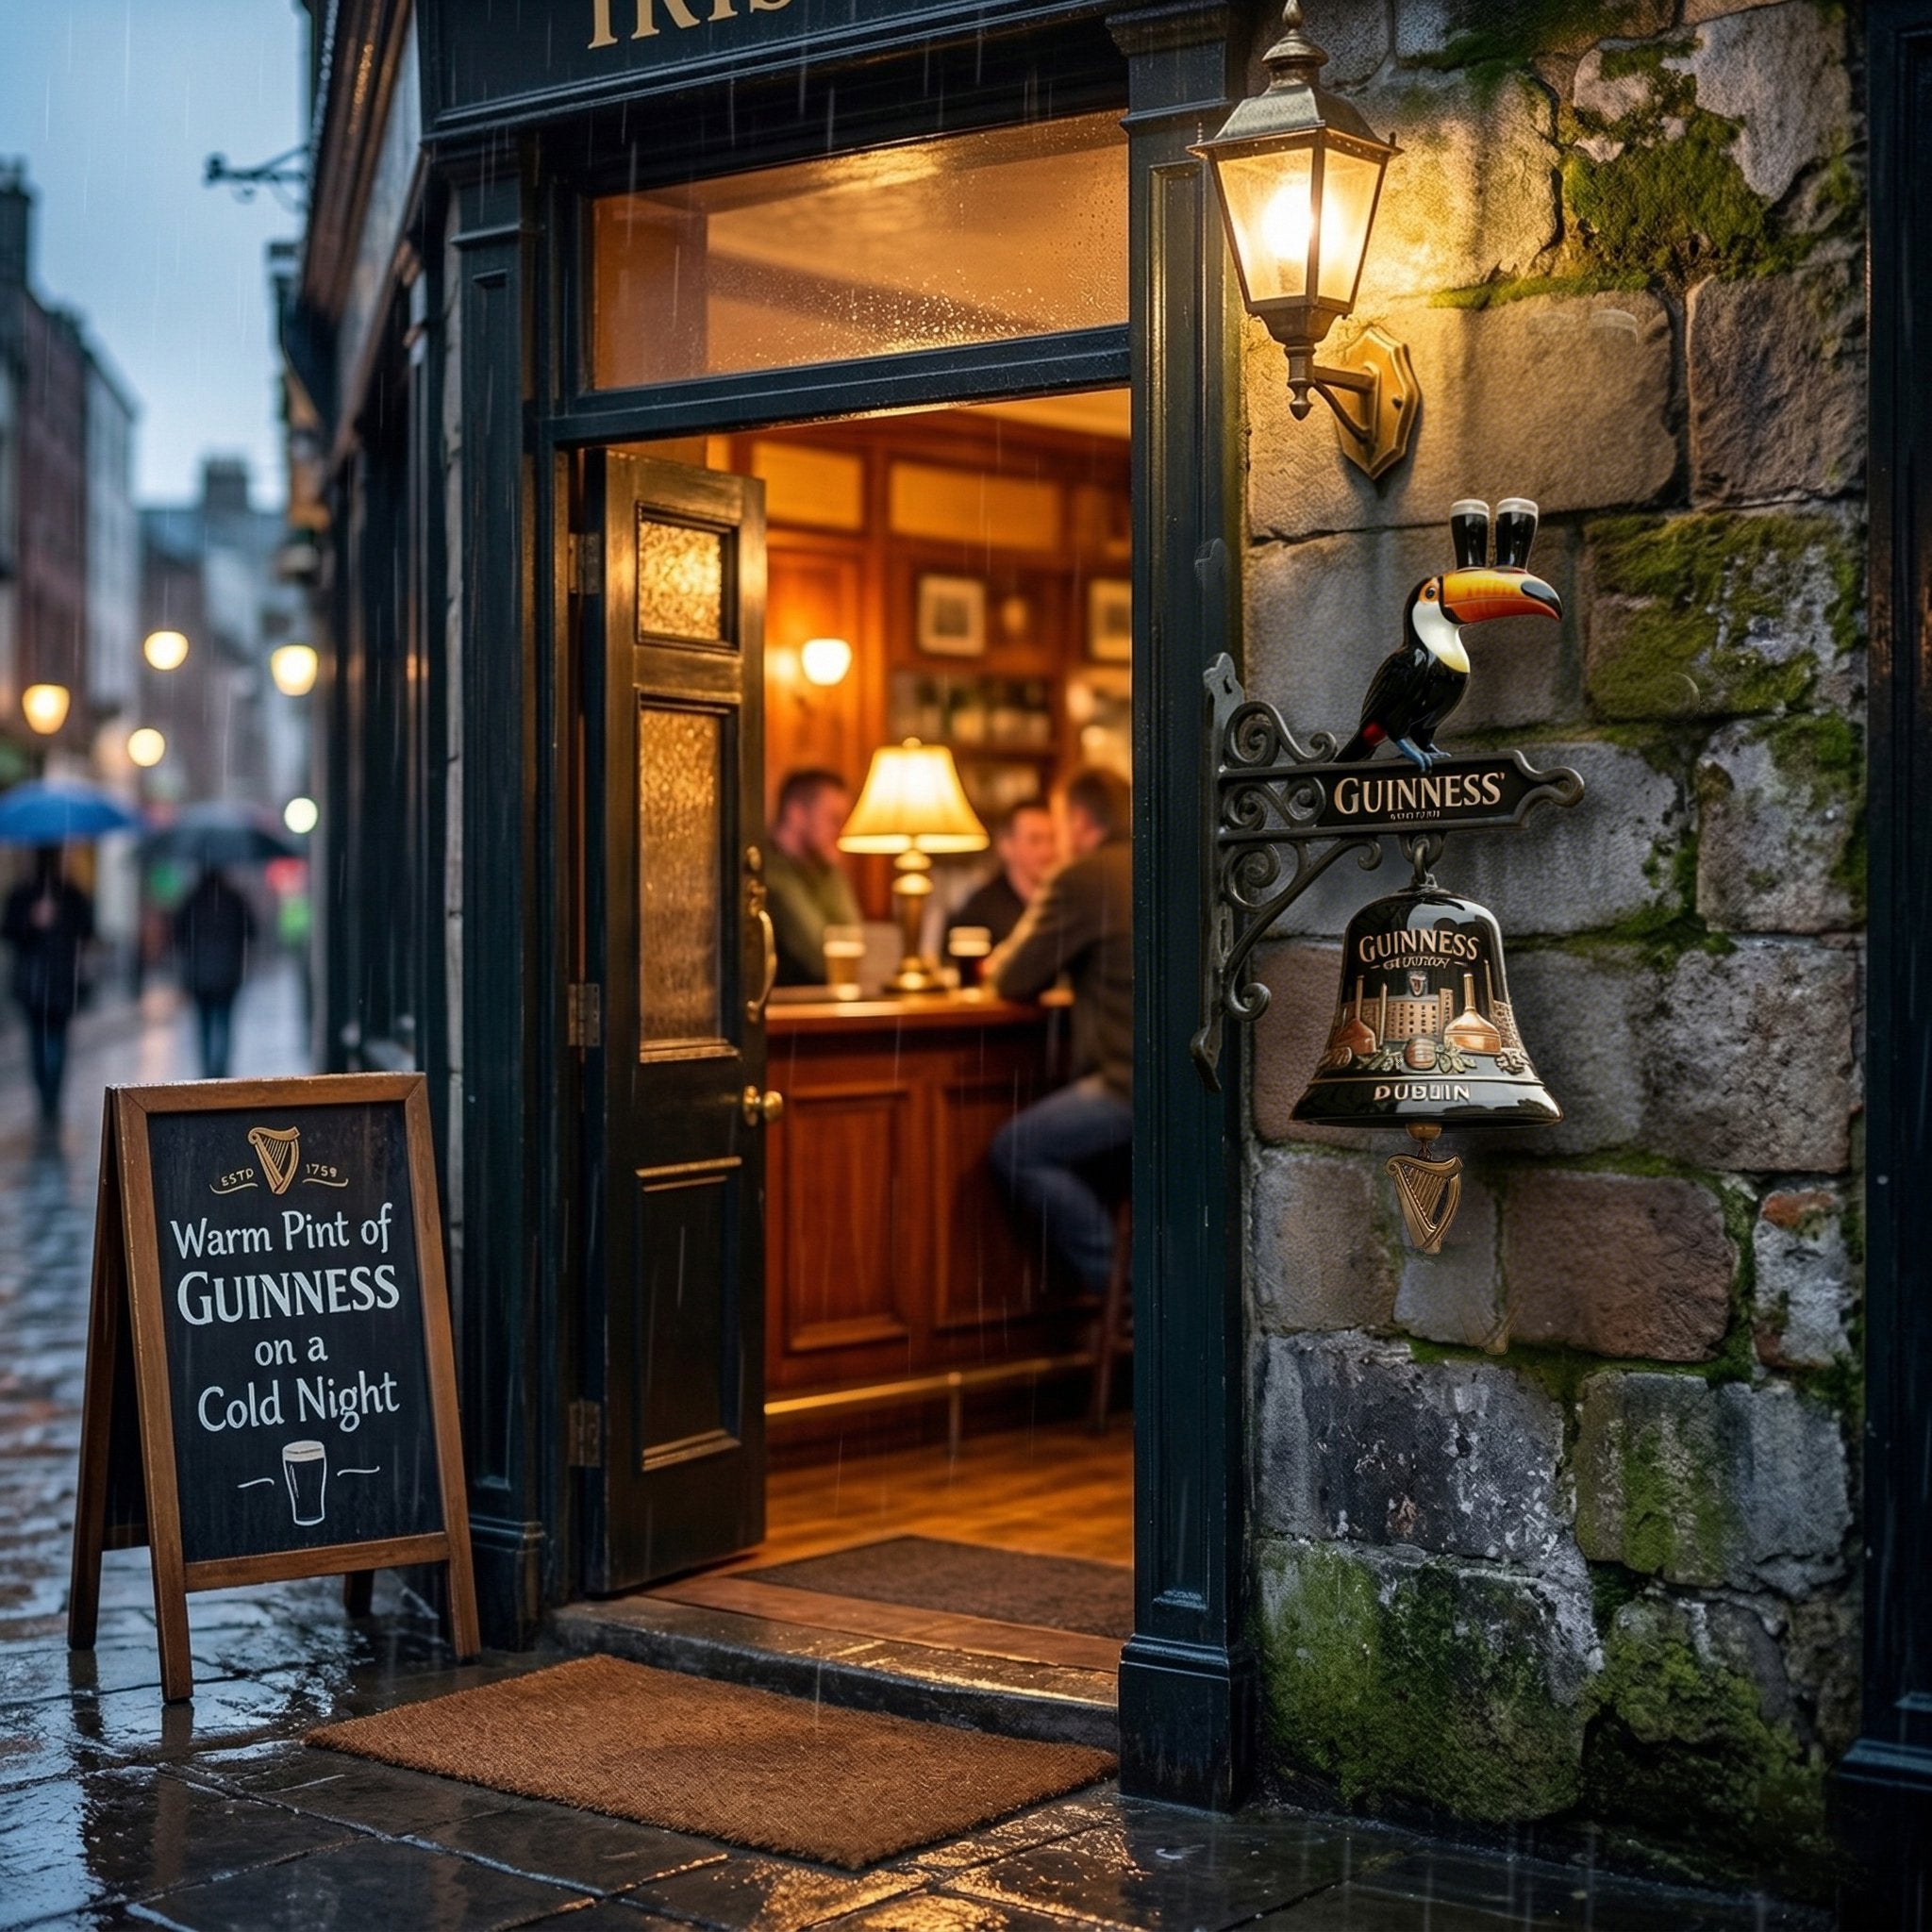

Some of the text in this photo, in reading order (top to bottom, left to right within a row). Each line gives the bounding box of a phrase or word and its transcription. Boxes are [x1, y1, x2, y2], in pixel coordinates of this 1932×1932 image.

[1358, 928, 1481, 963] GUINNESS
[221, 1163, 338, 1187] ESTD 1759
[170, 1202, 392, 1259] Warm Pint of
[176, 1264, 400, 1325] GUINNESS
[254, 1336, 328, 1366] on a
[197, 1370, 400, 1433] Cold Night
